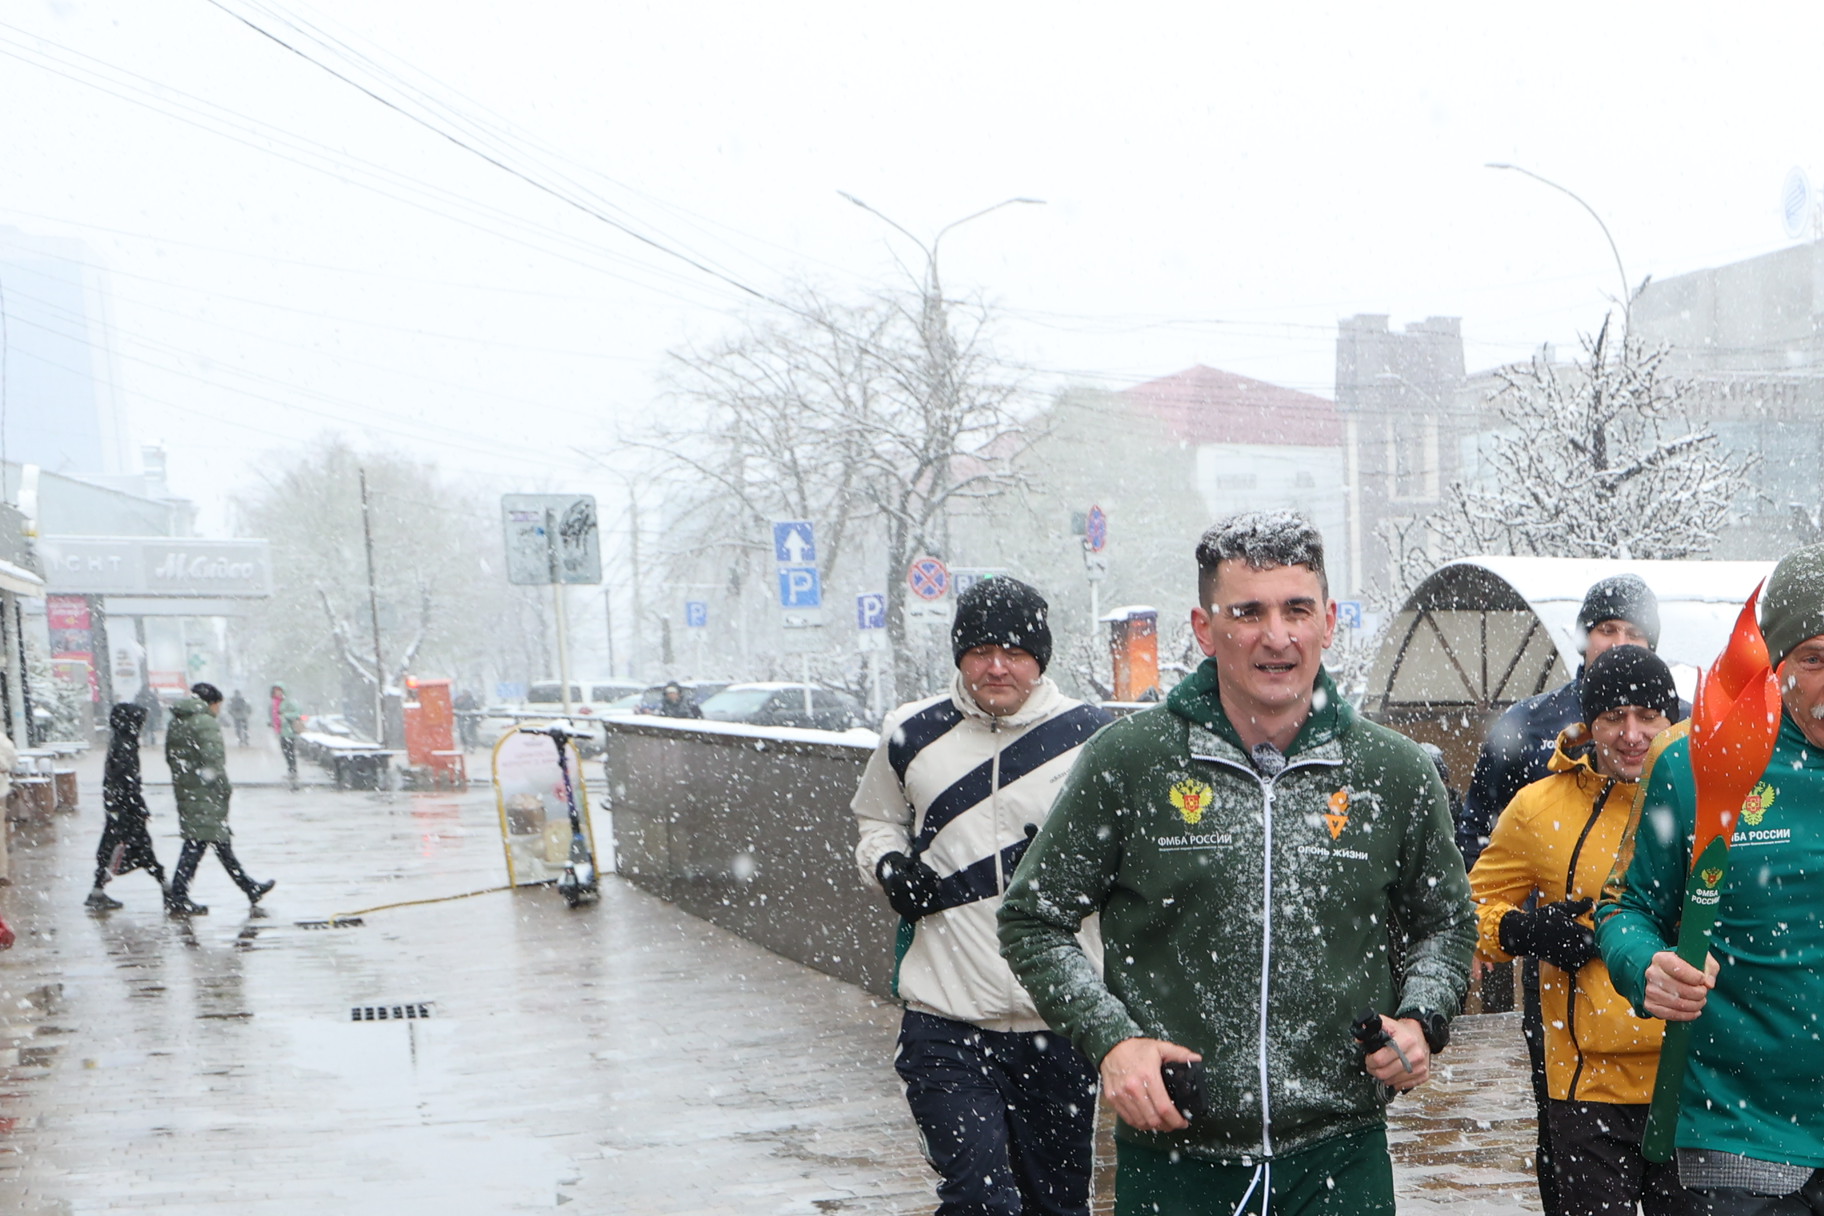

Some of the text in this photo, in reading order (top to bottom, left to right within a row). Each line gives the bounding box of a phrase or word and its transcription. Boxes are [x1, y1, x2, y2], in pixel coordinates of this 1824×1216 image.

[1157, 834, 1232, 847] ФМБА РОССИИ
[1749, 828, 1791, 841] РОССИИ
[1297, 845, 1369, 860] ОГОНЬ ЖИЗНИ
[1695, 888, 1719, 897] ФМБА
[1691, 895, 1721, 905] РОССИИ
